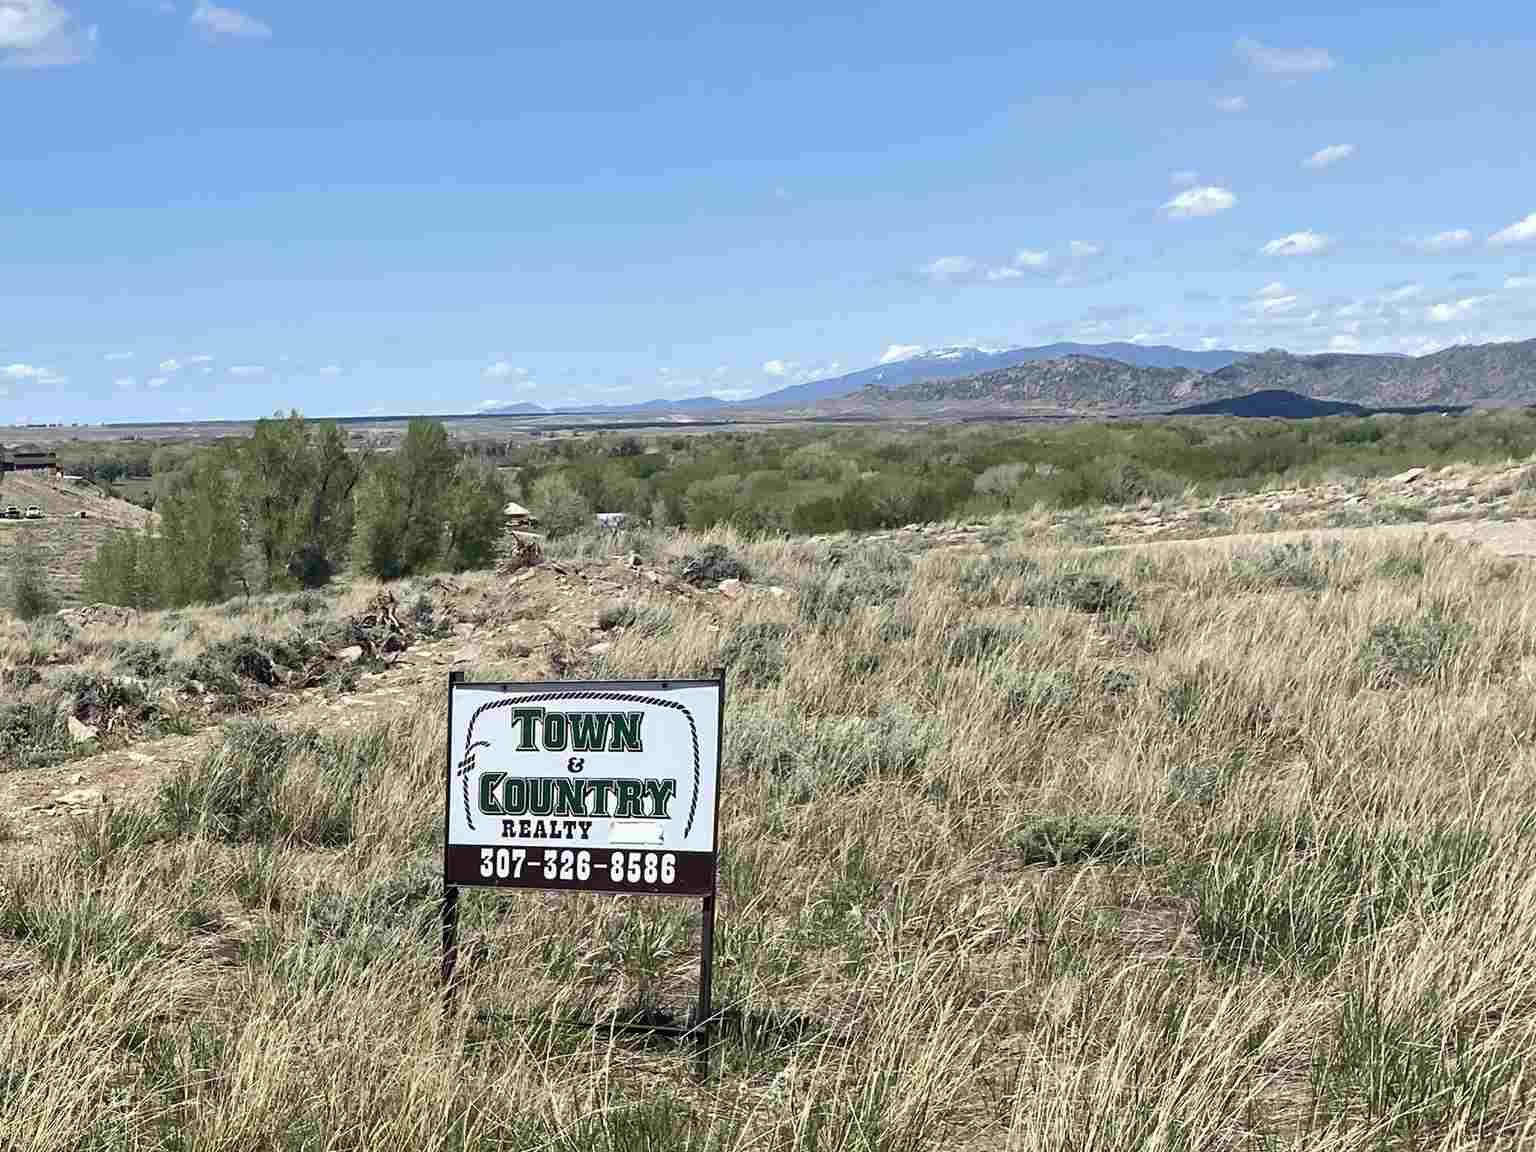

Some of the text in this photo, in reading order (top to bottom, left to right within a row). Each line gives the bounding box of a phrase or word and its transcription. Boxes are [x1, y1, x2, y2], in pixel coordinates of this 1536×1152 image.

[511, 706, 644, 752] TOWN
[567, 757, 584, 773] &
[478, 772, 676, 819] COUNTRY
[502, 819, 592, 840] REALTY
[480, 848, 676, 884] 307-326-8586
